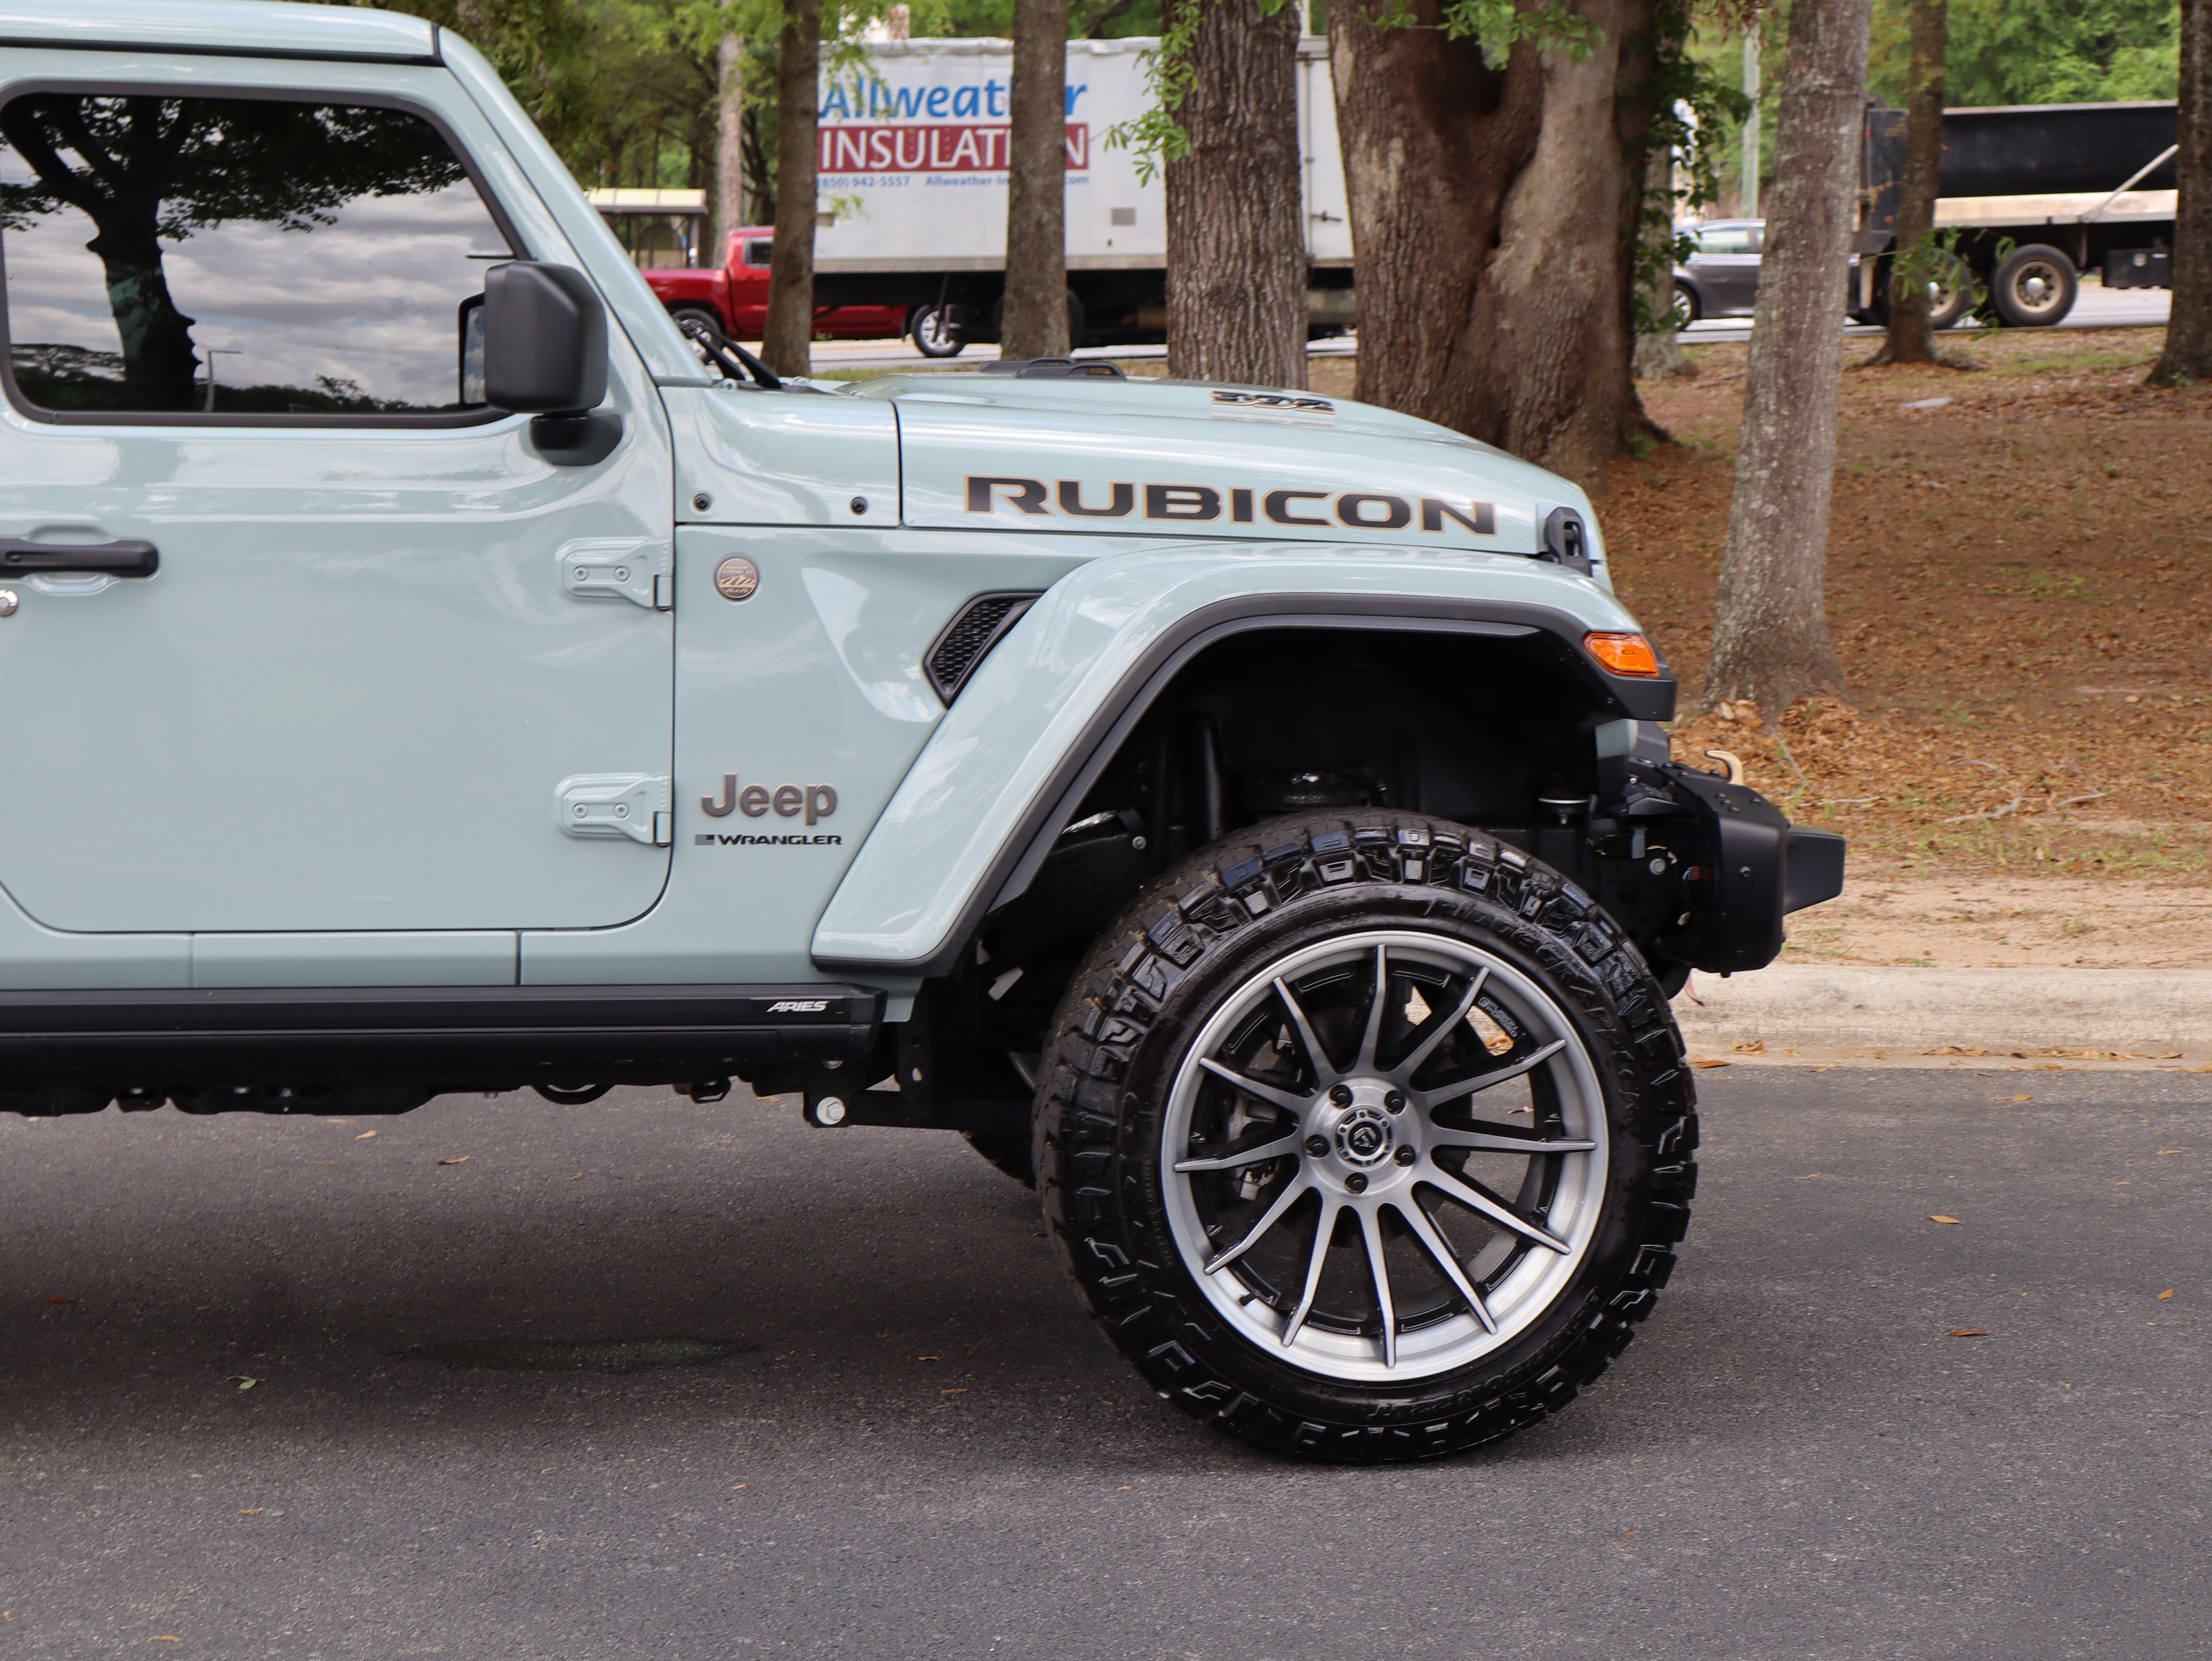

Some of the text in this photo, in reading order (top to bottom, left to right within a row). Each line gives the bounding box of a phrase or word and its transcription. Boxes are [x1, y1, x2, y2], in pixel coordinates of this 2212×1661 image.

[818, 75, 1088, 118] Allweatr
[822, 127, 1085, 169] INSULATIN
[964, 474, 1498, 537] RUBICON
[700, 772, 837, 826] Jeep
[717, 834, 842, 845] WRANGLER
[766, 1000, 830, 1012] ARIES
